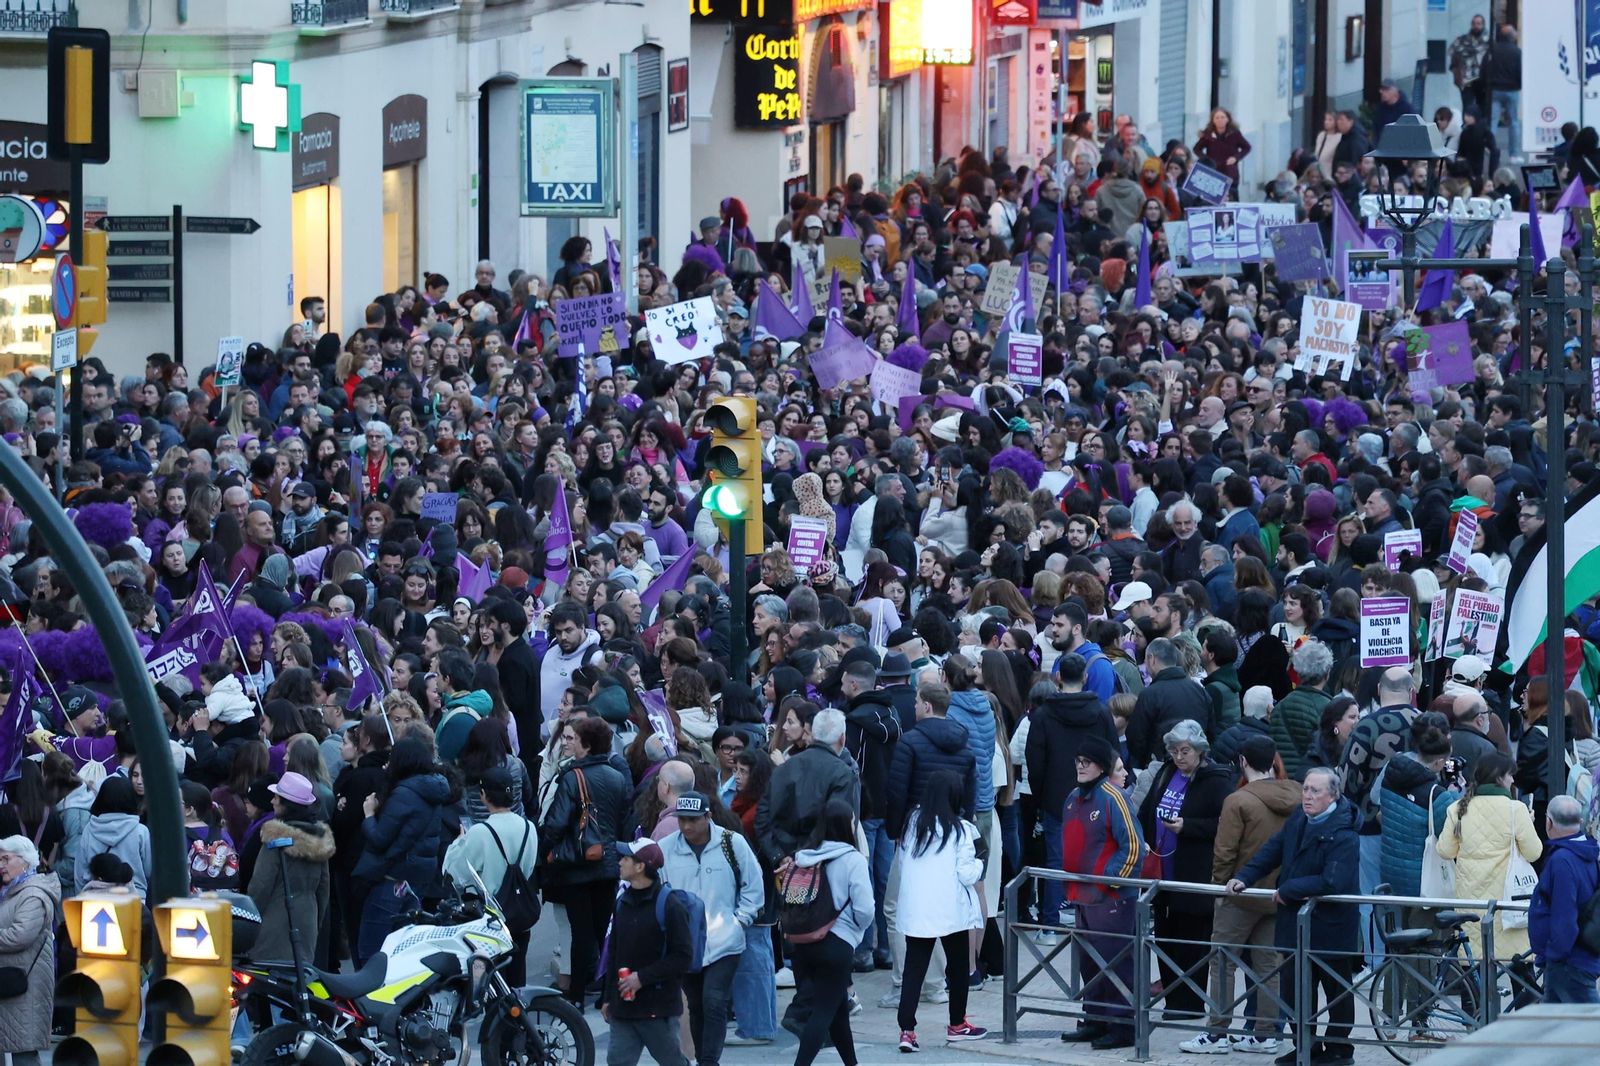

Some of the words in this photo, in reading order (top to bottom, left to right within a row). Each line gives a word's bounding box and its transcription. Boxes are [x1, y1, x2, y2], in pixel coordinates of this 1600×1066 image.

[774, 64, 796, 90] de
[299, 126, 332, 153] Farmacia
[389, 118, 420, 147] Apotheke
[538, 183, 592, 200] TAXI
[573, 301, 586, 311] UN
[601, 297, 613, 306] NO
[601, 306, 612, 316] LO
[647, 312, 657, 321] YO
[684, 301, 696, 309] TE
[1311, 299, 1329, 318] YO
[1334, 303, 1356, 321] NO
[560, 318, 597, 334] QUEMO
[602, 312, 626, 326] TODO
[1314, 320, 1345, 339] SOY
[1305, 335, 1350, 355] MACHISTA
[1459, 598, 1472, 609] DEL
[1472, 601, 1500, 613] PUEBLO
[1370, 617, 1392, 627] BASTA
[1392, 616, 1401, 625] YA
[1456, 607, 1498, 624] PALESTINO
[1382, 628, 1390, 636] DE
[1368, 637, 1403, 647] VIOLENCIA
[1368, 647, 1403, 657] MACHISTA
[677, 798, 699, 810] MARVEL
